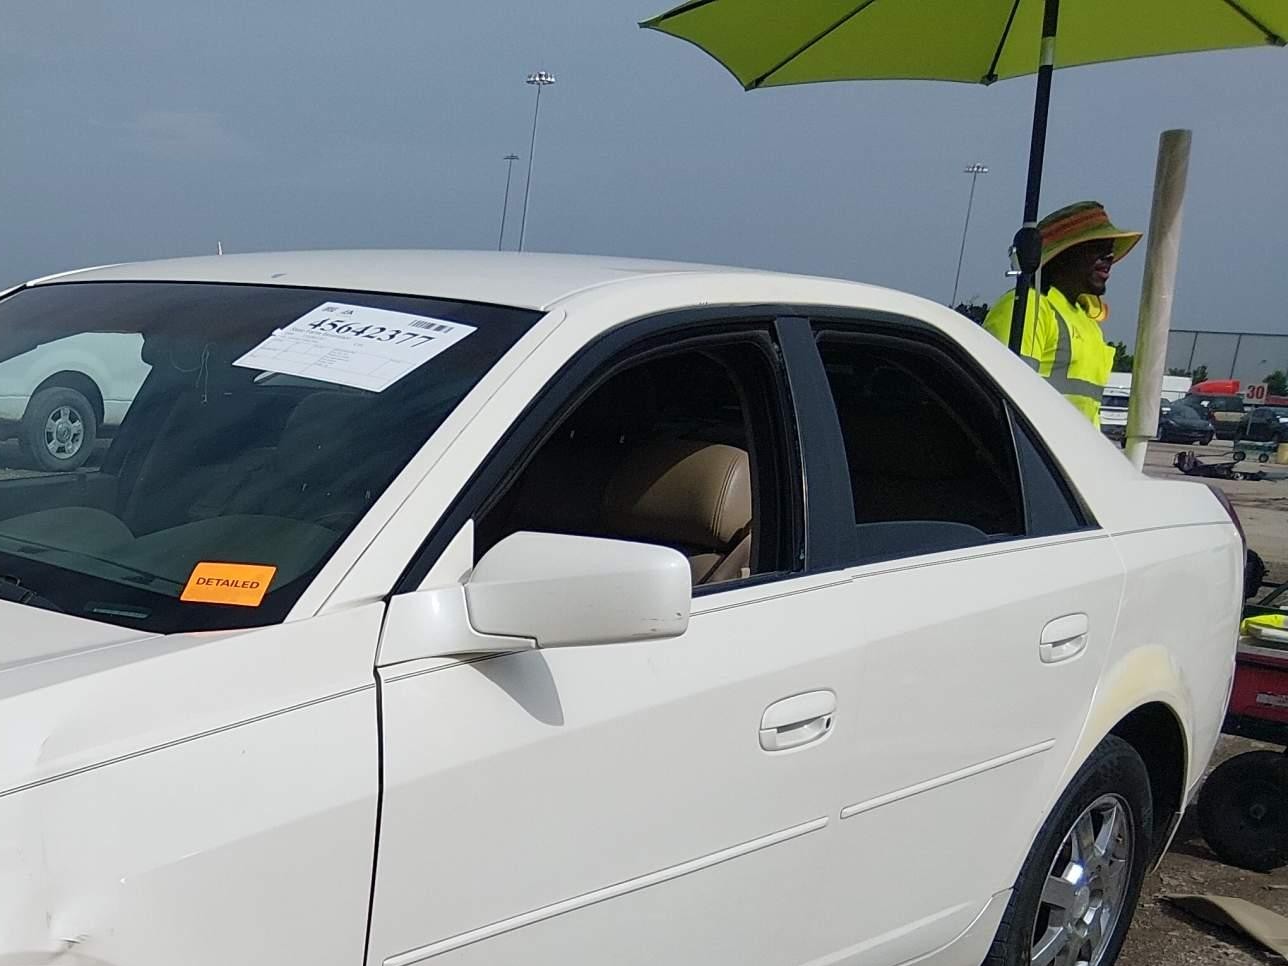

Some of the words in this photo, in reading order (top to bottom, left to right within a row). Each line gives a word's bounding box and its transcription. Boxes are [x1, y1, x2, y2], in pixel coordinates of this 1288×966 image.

[308, 318, 435, 348] 45642377
[1247, 384, 1265, 399] 30
[196, 577, 260, 589] DETAILED
